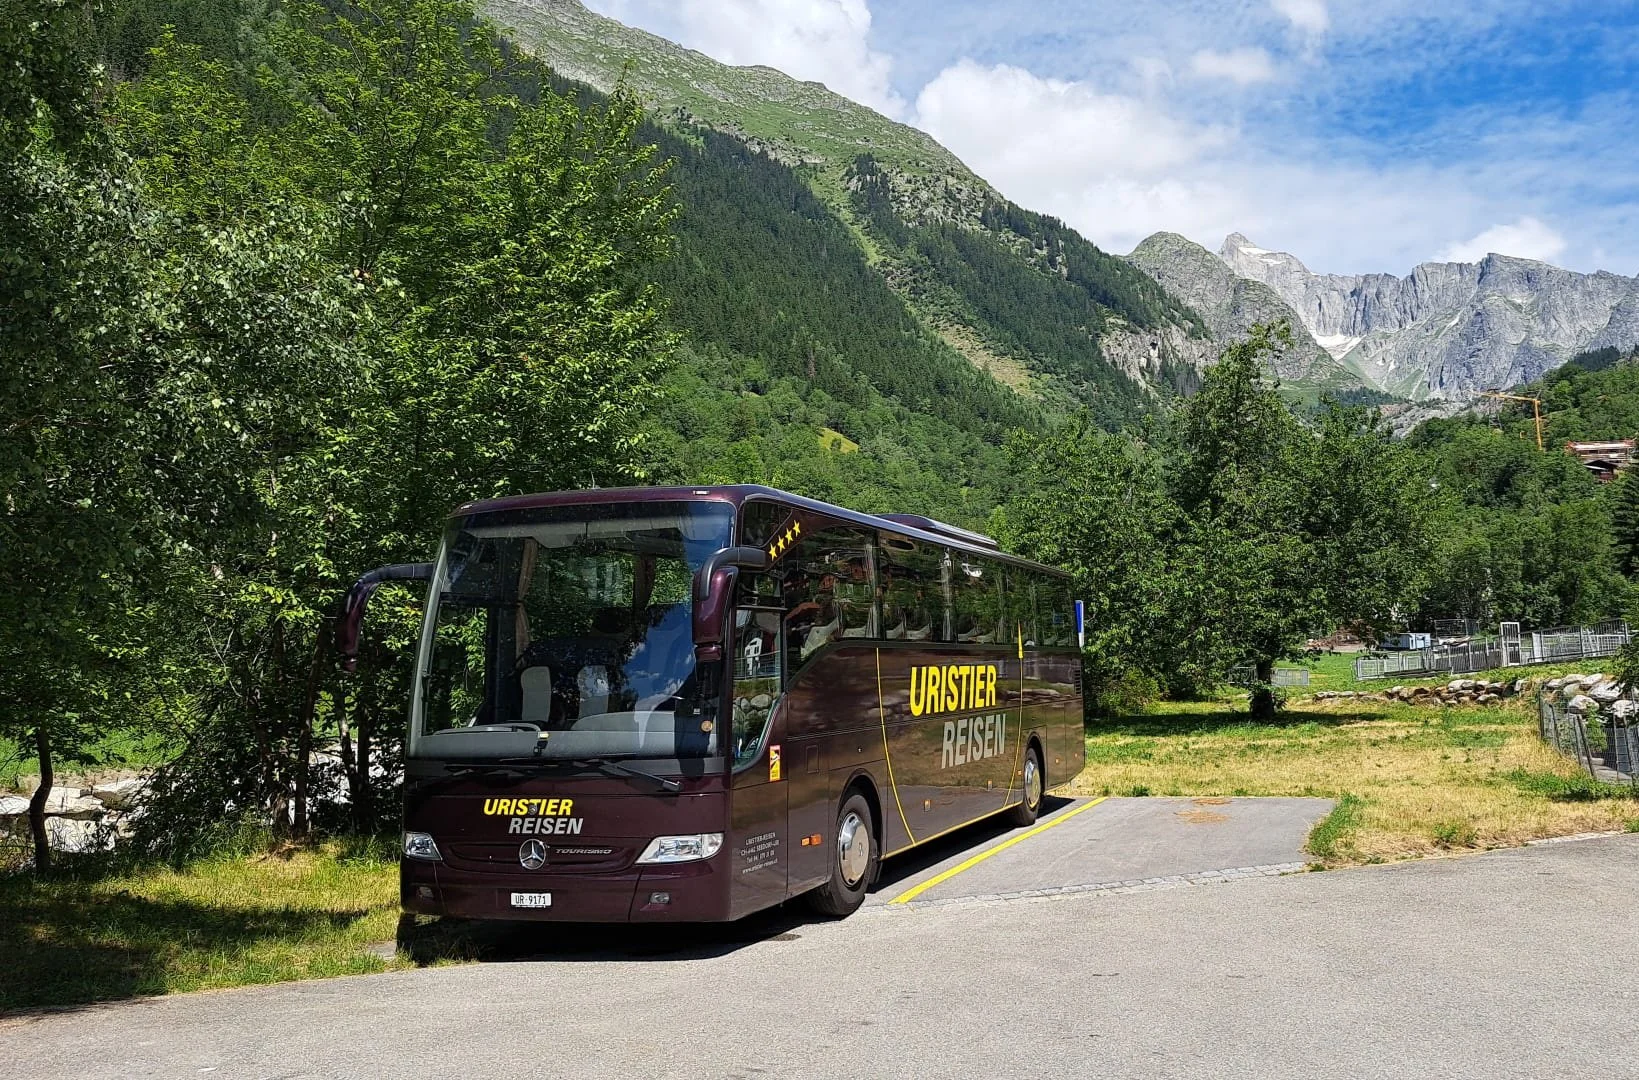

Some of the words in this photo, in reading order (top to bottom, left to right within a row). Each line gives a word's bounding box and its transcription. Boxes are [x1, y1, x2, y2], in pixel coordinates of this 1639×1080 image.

[910, 665, 997, 717] URISTIER
[941, 713, 1006, 769] REISEN
[483, 798, 574, 816] URISTIER
[508, 817, 583, 835] REISEN
[528, 895, 546, 905] 9171
